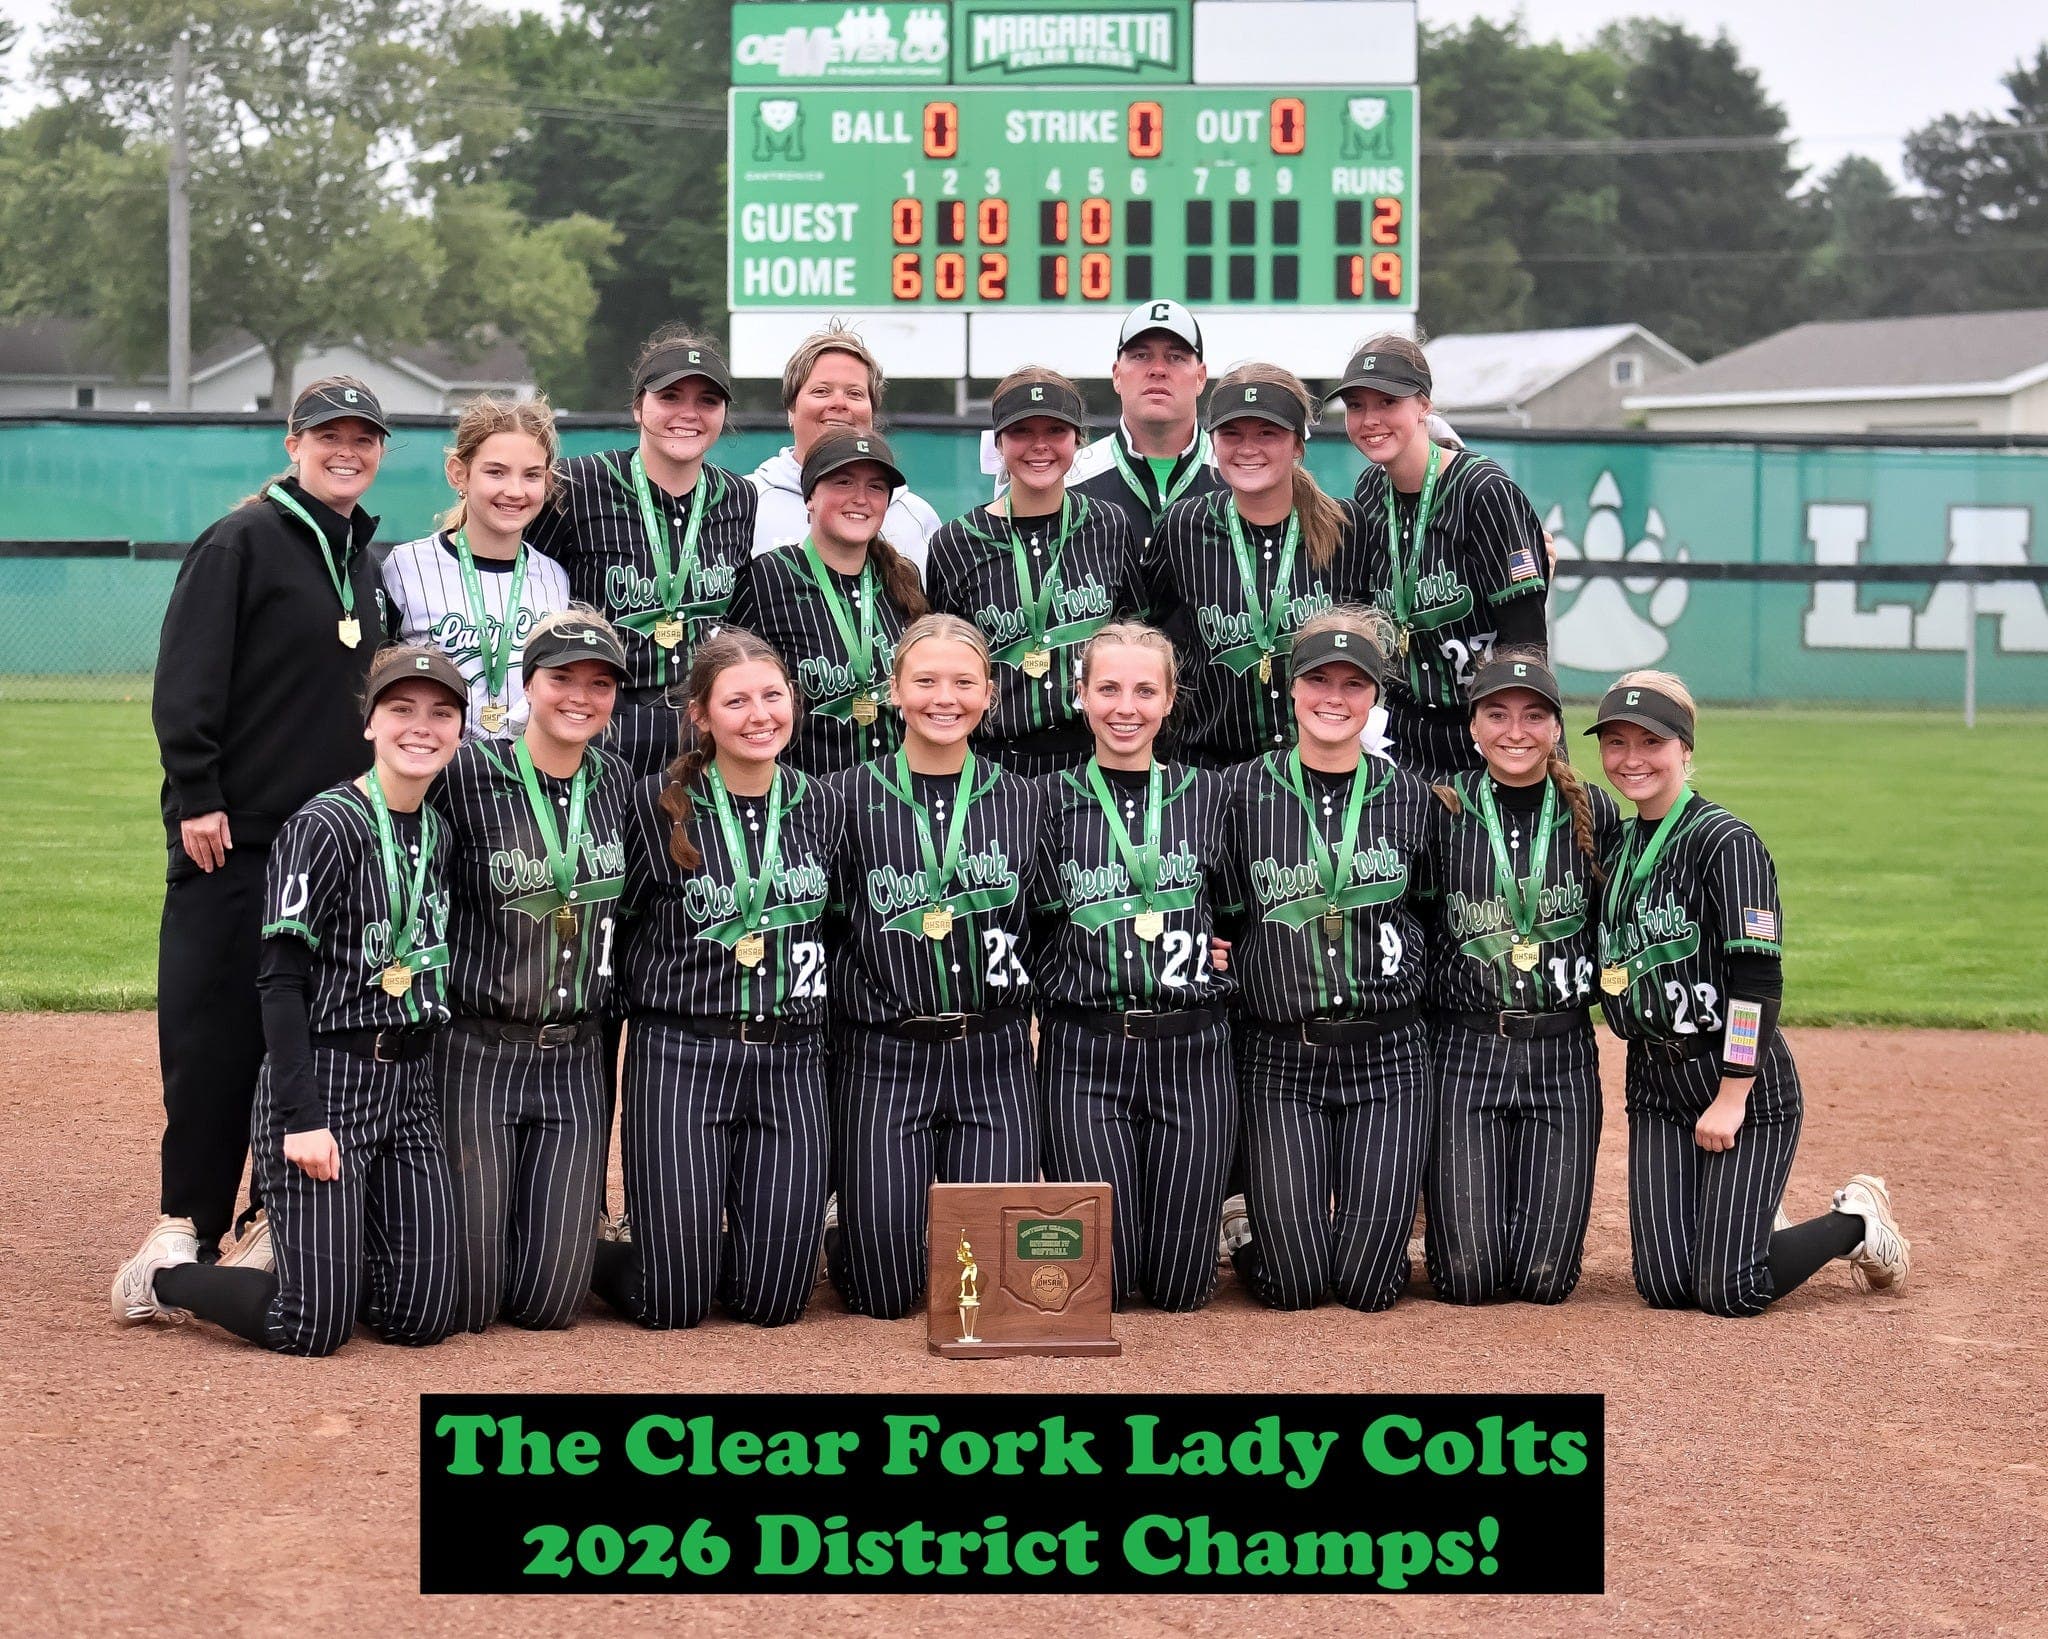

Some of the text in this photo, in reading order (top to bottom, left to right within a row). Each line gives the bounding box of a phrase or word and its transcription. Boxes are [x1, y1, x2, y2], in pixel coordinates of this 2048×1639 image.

[973, 13, 1172, 65] MARGARETTA
[831, 101, 958, 158] BALL 0
[1004, 101, 1164, 158] STRIKE 0
[1195, 97, 1306, 155] OUT 0
[902, 166, 1405, 195] 1 2 3 4 5 6 7 8 9 RUNS
[741, 197, 1402, 245] GUEST 0 1 0 1 0 2
[743, 251, 1401, 300] HOME 6 0 2 1 0 19
[1149, 303, 1170, 322] C
[688, 350, 701, 364] C
[1363, 356, 1377, 371] C
[345, 389, 359, 403] C
[1031, 387, 1044, 401] C
[1245, 387, 1258, 402] C
[857, 440, 870, 453] C
[606, 564, 678, 611] Cle
[1405, 558, 1462, 609] ork
[584, 629, 598, 645] C
[974, 603, 1040, 648] Clea
[1197, 603, 1264, 650] Clea
[1334, 633, 1348, 648] C
[415, 656, 430, 671] C
[797, 655, 878, 700] Cle
[1438, 628, 1498, 686] 27
[1513, 662, 1527, 678] C
[1625, 690, 1640, 706] C
[489, 847, 579, 895] Cle
[866, 864, 949, 915] Clea
[1058, 859, 1130, 908] Clear
[682, 874, 759, 923] Cle
[1160, 929, 1210, 988] 21
